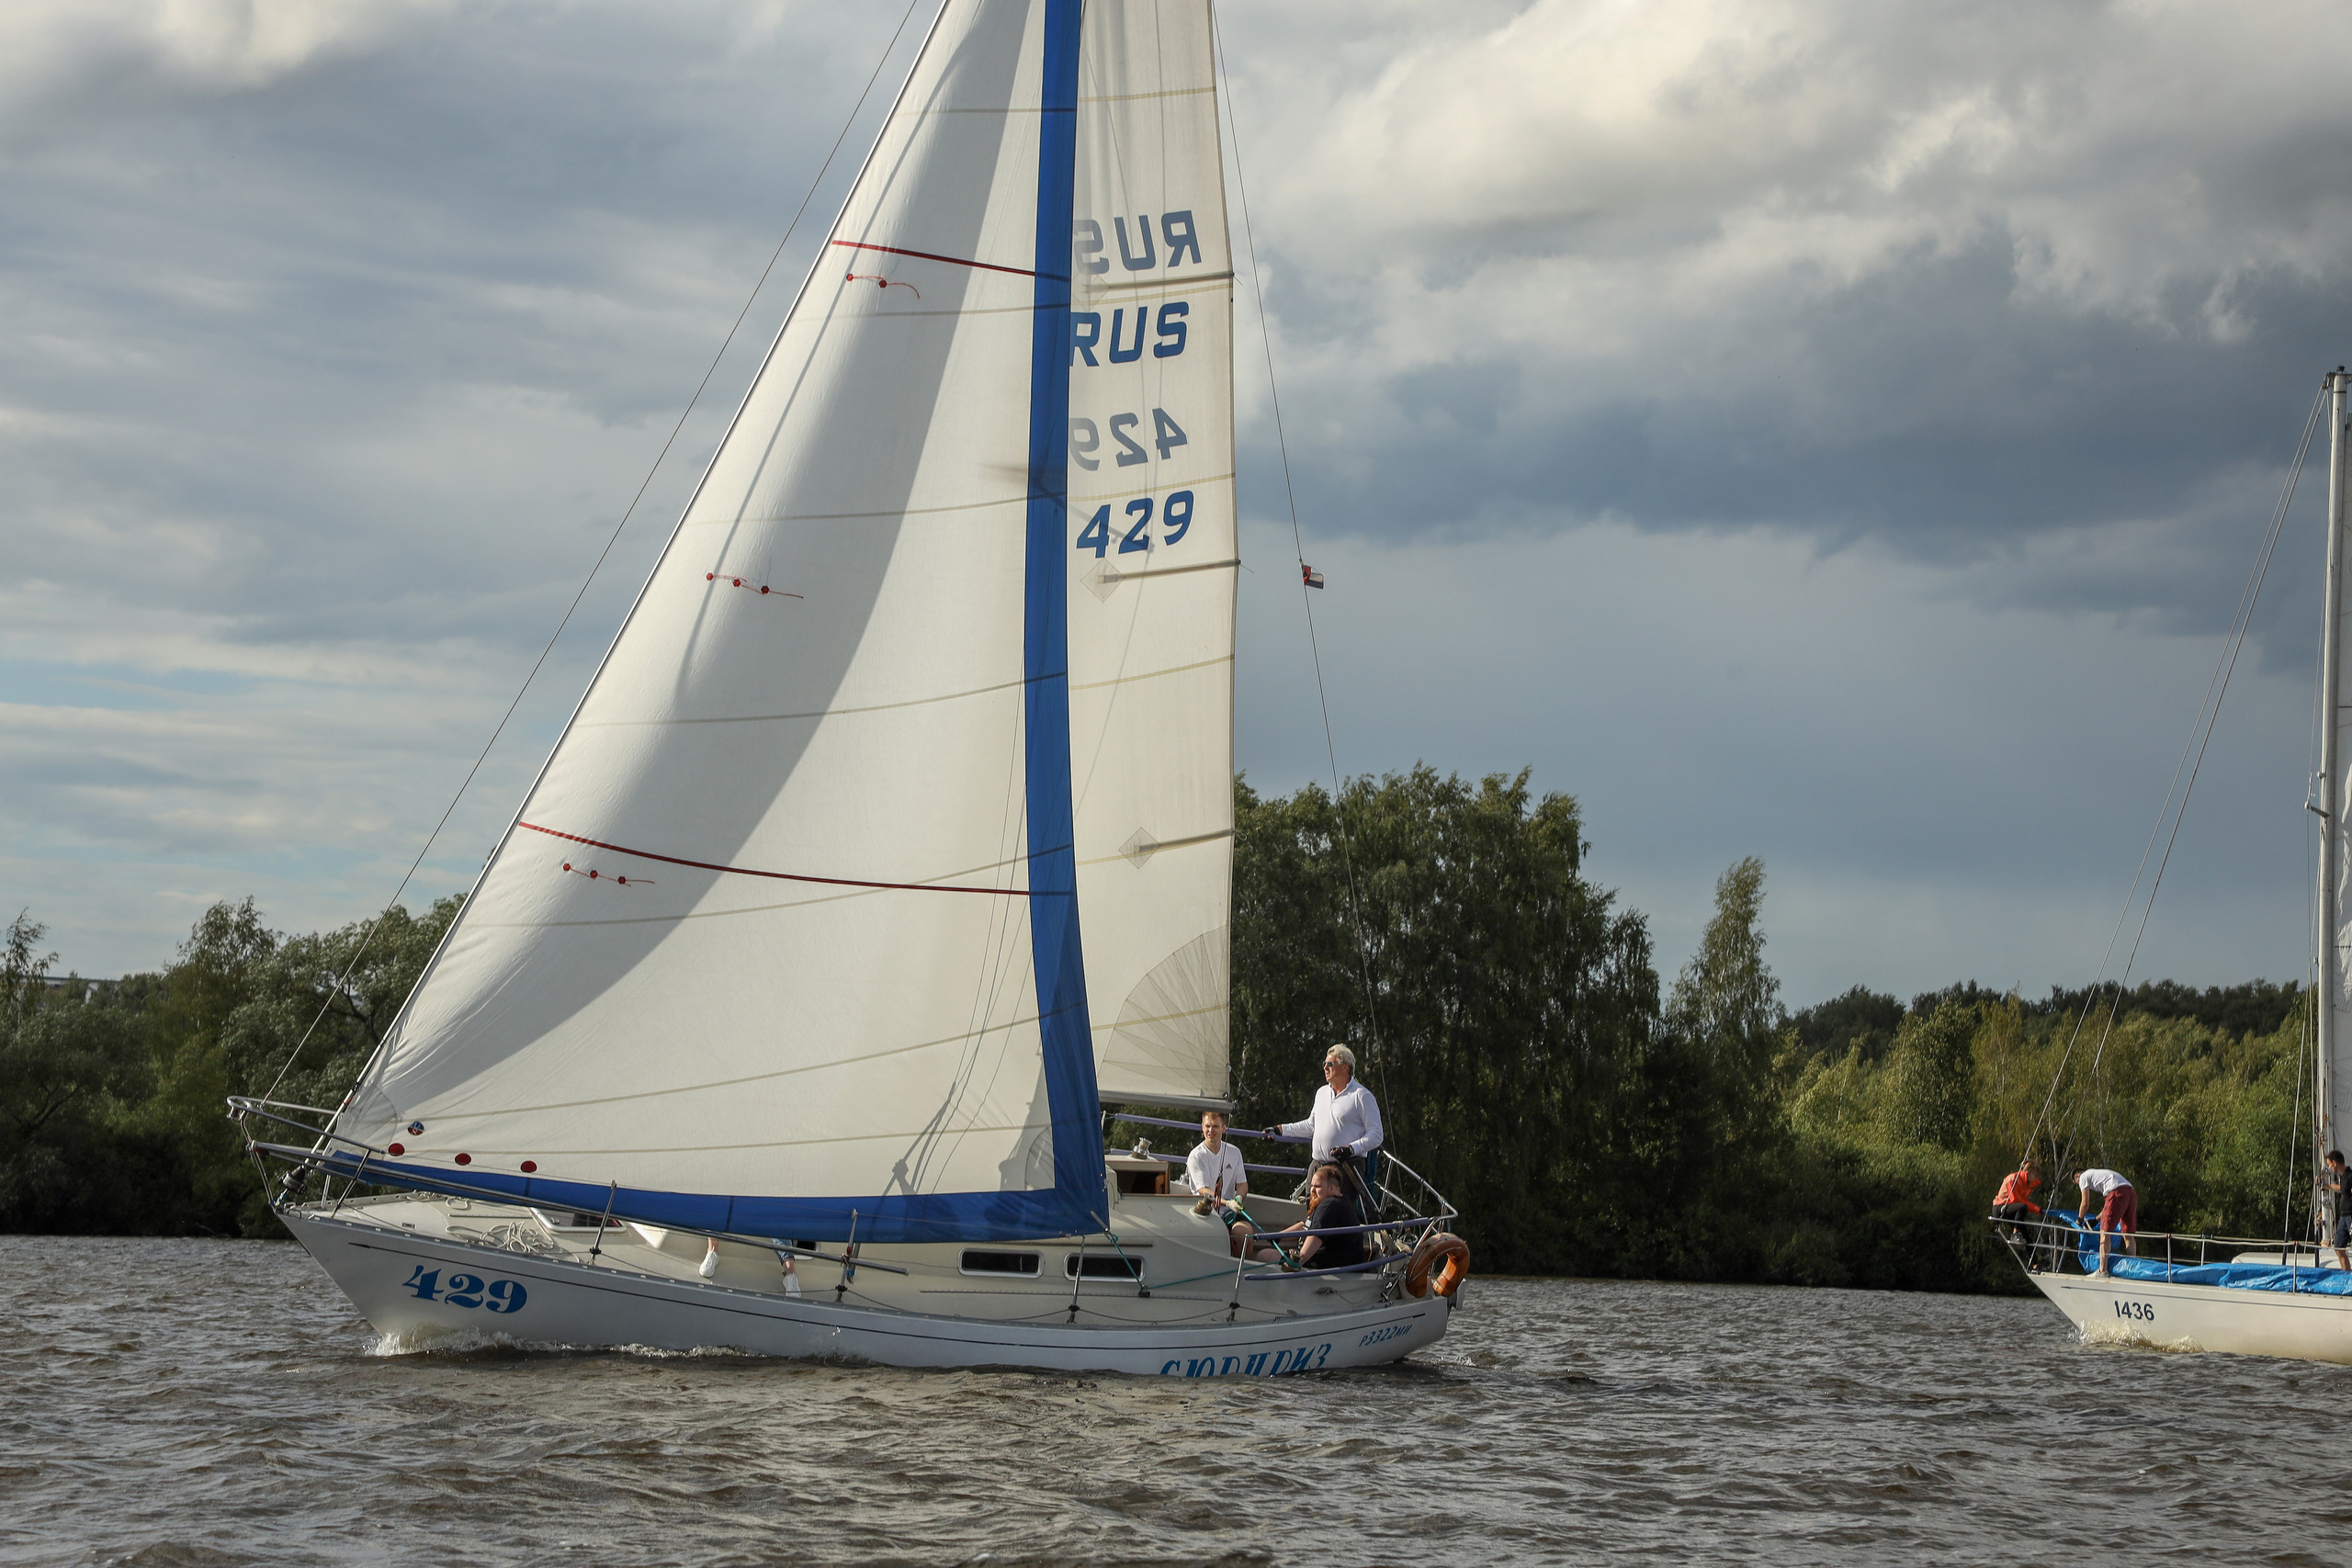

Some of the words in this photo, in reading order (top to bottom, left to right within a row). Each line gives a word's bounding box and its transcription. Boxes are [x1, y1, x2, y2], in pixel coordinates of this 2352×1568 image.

[1069, 301, 1189, 367] RUS
[1076, 490, 1194, 558] 429
[401, 1265, 527, 1314] 429
[2114, 1300, 2155, 1321] 1436
